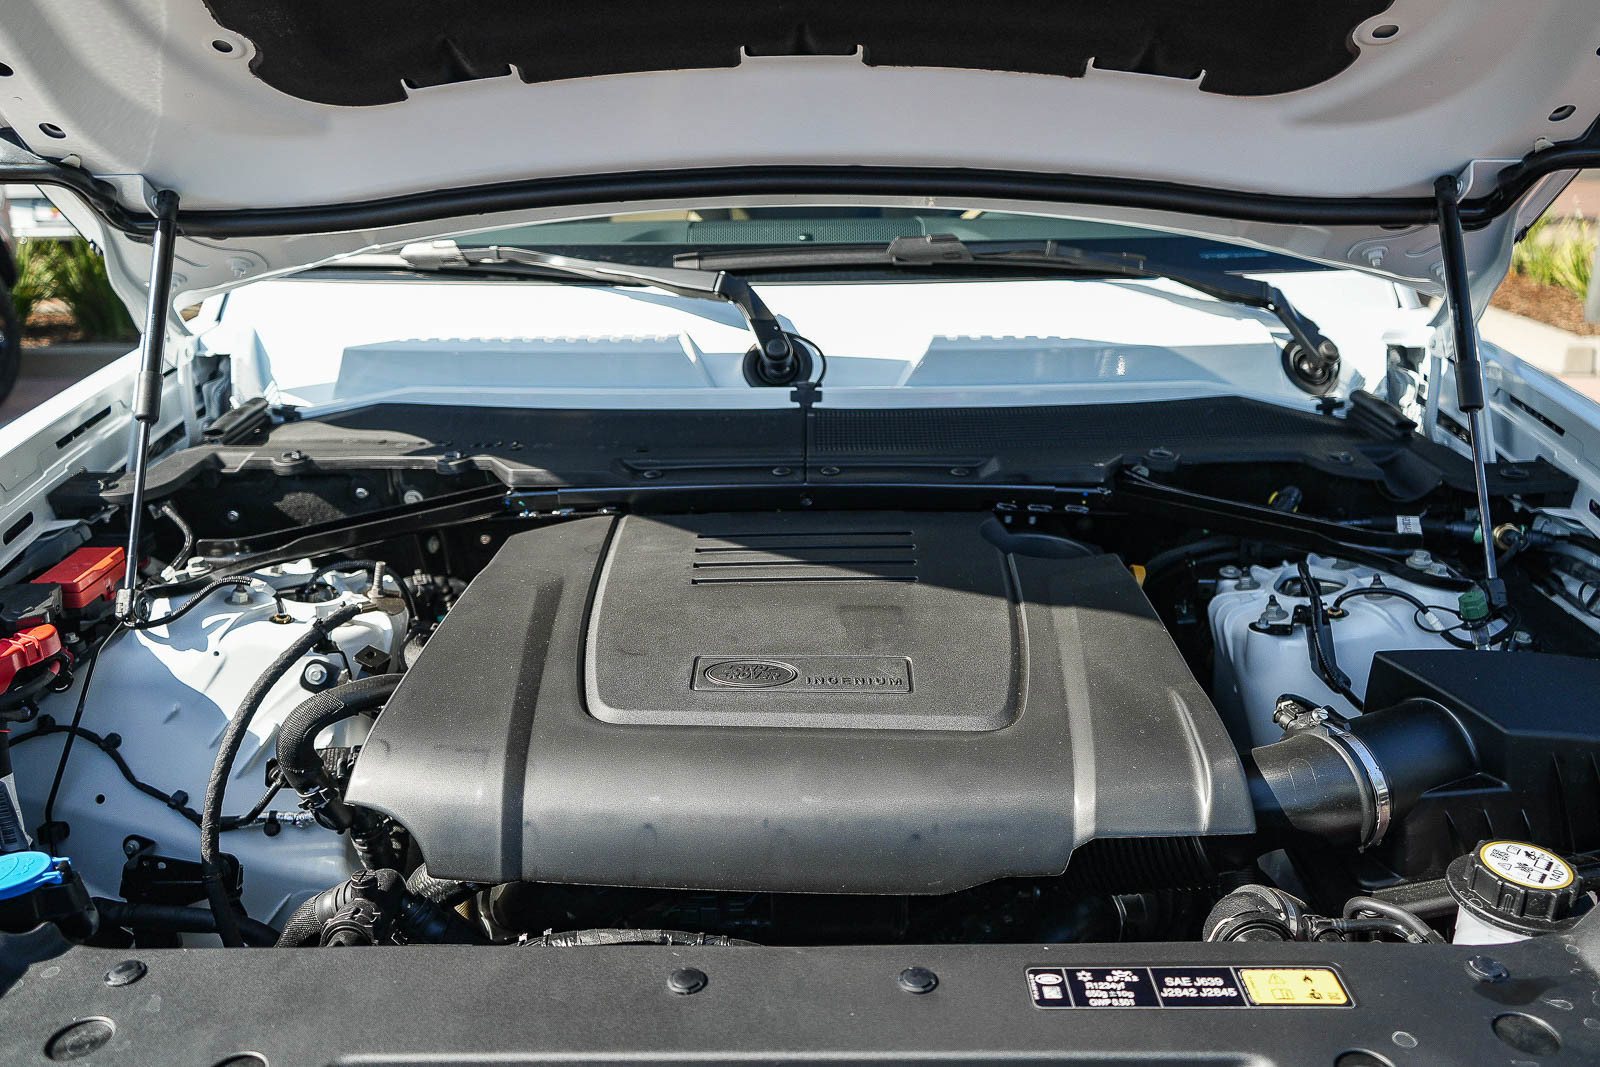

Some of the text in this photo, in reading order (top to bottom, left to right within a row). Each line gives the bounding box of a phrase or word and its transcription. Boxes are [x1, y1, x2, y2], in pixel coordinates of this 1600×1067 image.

[724, 671, 782, 680] ROVER
[805, 676, 904, 686] INGENIUM
[1164, 977, 1224, 986] SAE J639
[1160, 987, 1238, 997] J2842 J2845
